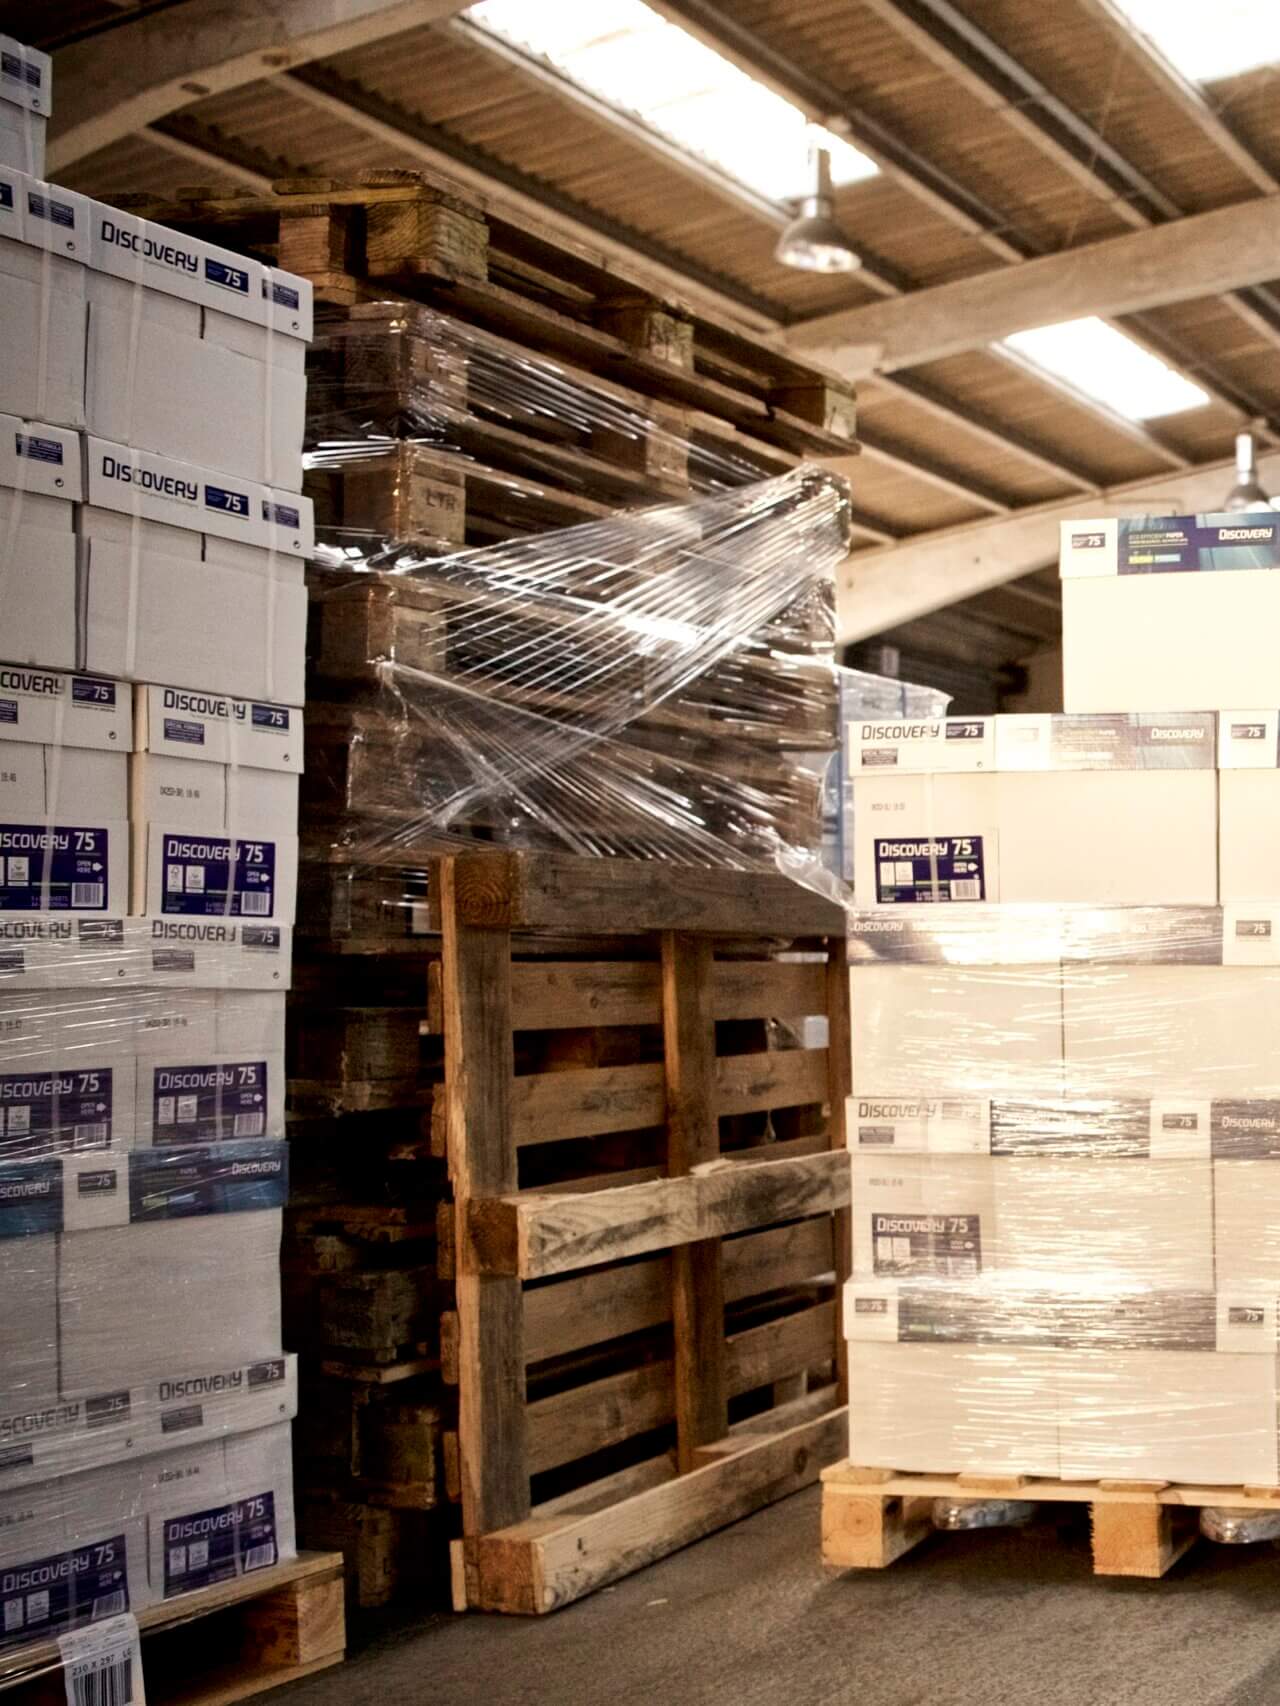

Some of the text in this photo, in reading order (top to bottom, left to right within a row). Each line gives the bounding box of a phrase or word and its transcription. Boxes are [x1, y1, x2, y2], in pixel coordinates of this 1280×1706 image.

[102, 221, 198, 272] DISCOVERY
[224, 267, 242, 288] 75
[102, 456, 198, 500] DISCOVERY
[224, 494, 242, 511] 75
[1087, 536, 1101, 546] 75
[1218, 528, 1272, 540] DISCOVERY
[94, 686, 109, 700] 75
[164, 689, 246, 720] DISCOVEY
[269, 711, 284, 725] 75
[964, 725, 979, 737] 75
[1151, 727, 1205, 739] DISCOVERY
[1248, 727, 1261, 737] 75
[74, 831, 95, 851] 75
[879, 839, 973, 857] DISCOVERY 75
[245, 844, 263, 863] 75
[1253, 923, 1266, 934] 75
[260, 930, 274, 943] 75
[78, 1073, 100, 1093] 75
[159, 1066, 257, 1089] DISCOVERY 75
[1180, 1117, 1192, 1127] 75
[1222, 1116, 1275, 1128] DISCOVERY
[232, 1160, 281, 1176] DISCOVERY
[97, 1174, 111, 1187] 75
[877, 1217, 968, 1233] DISCOVERY 75
[870, 1301, 883, 1312] 75
[266, 1364, 280, 1379] 75
[168, 1511, 244, 1541] DISCOVERY
[247, 1499, 265, 1518] 75
[3, 1553, 90, 1593] DISCOVERY
[94, 1542, 115, 1566] 75
[100, 1654, 115, 1666] 297
